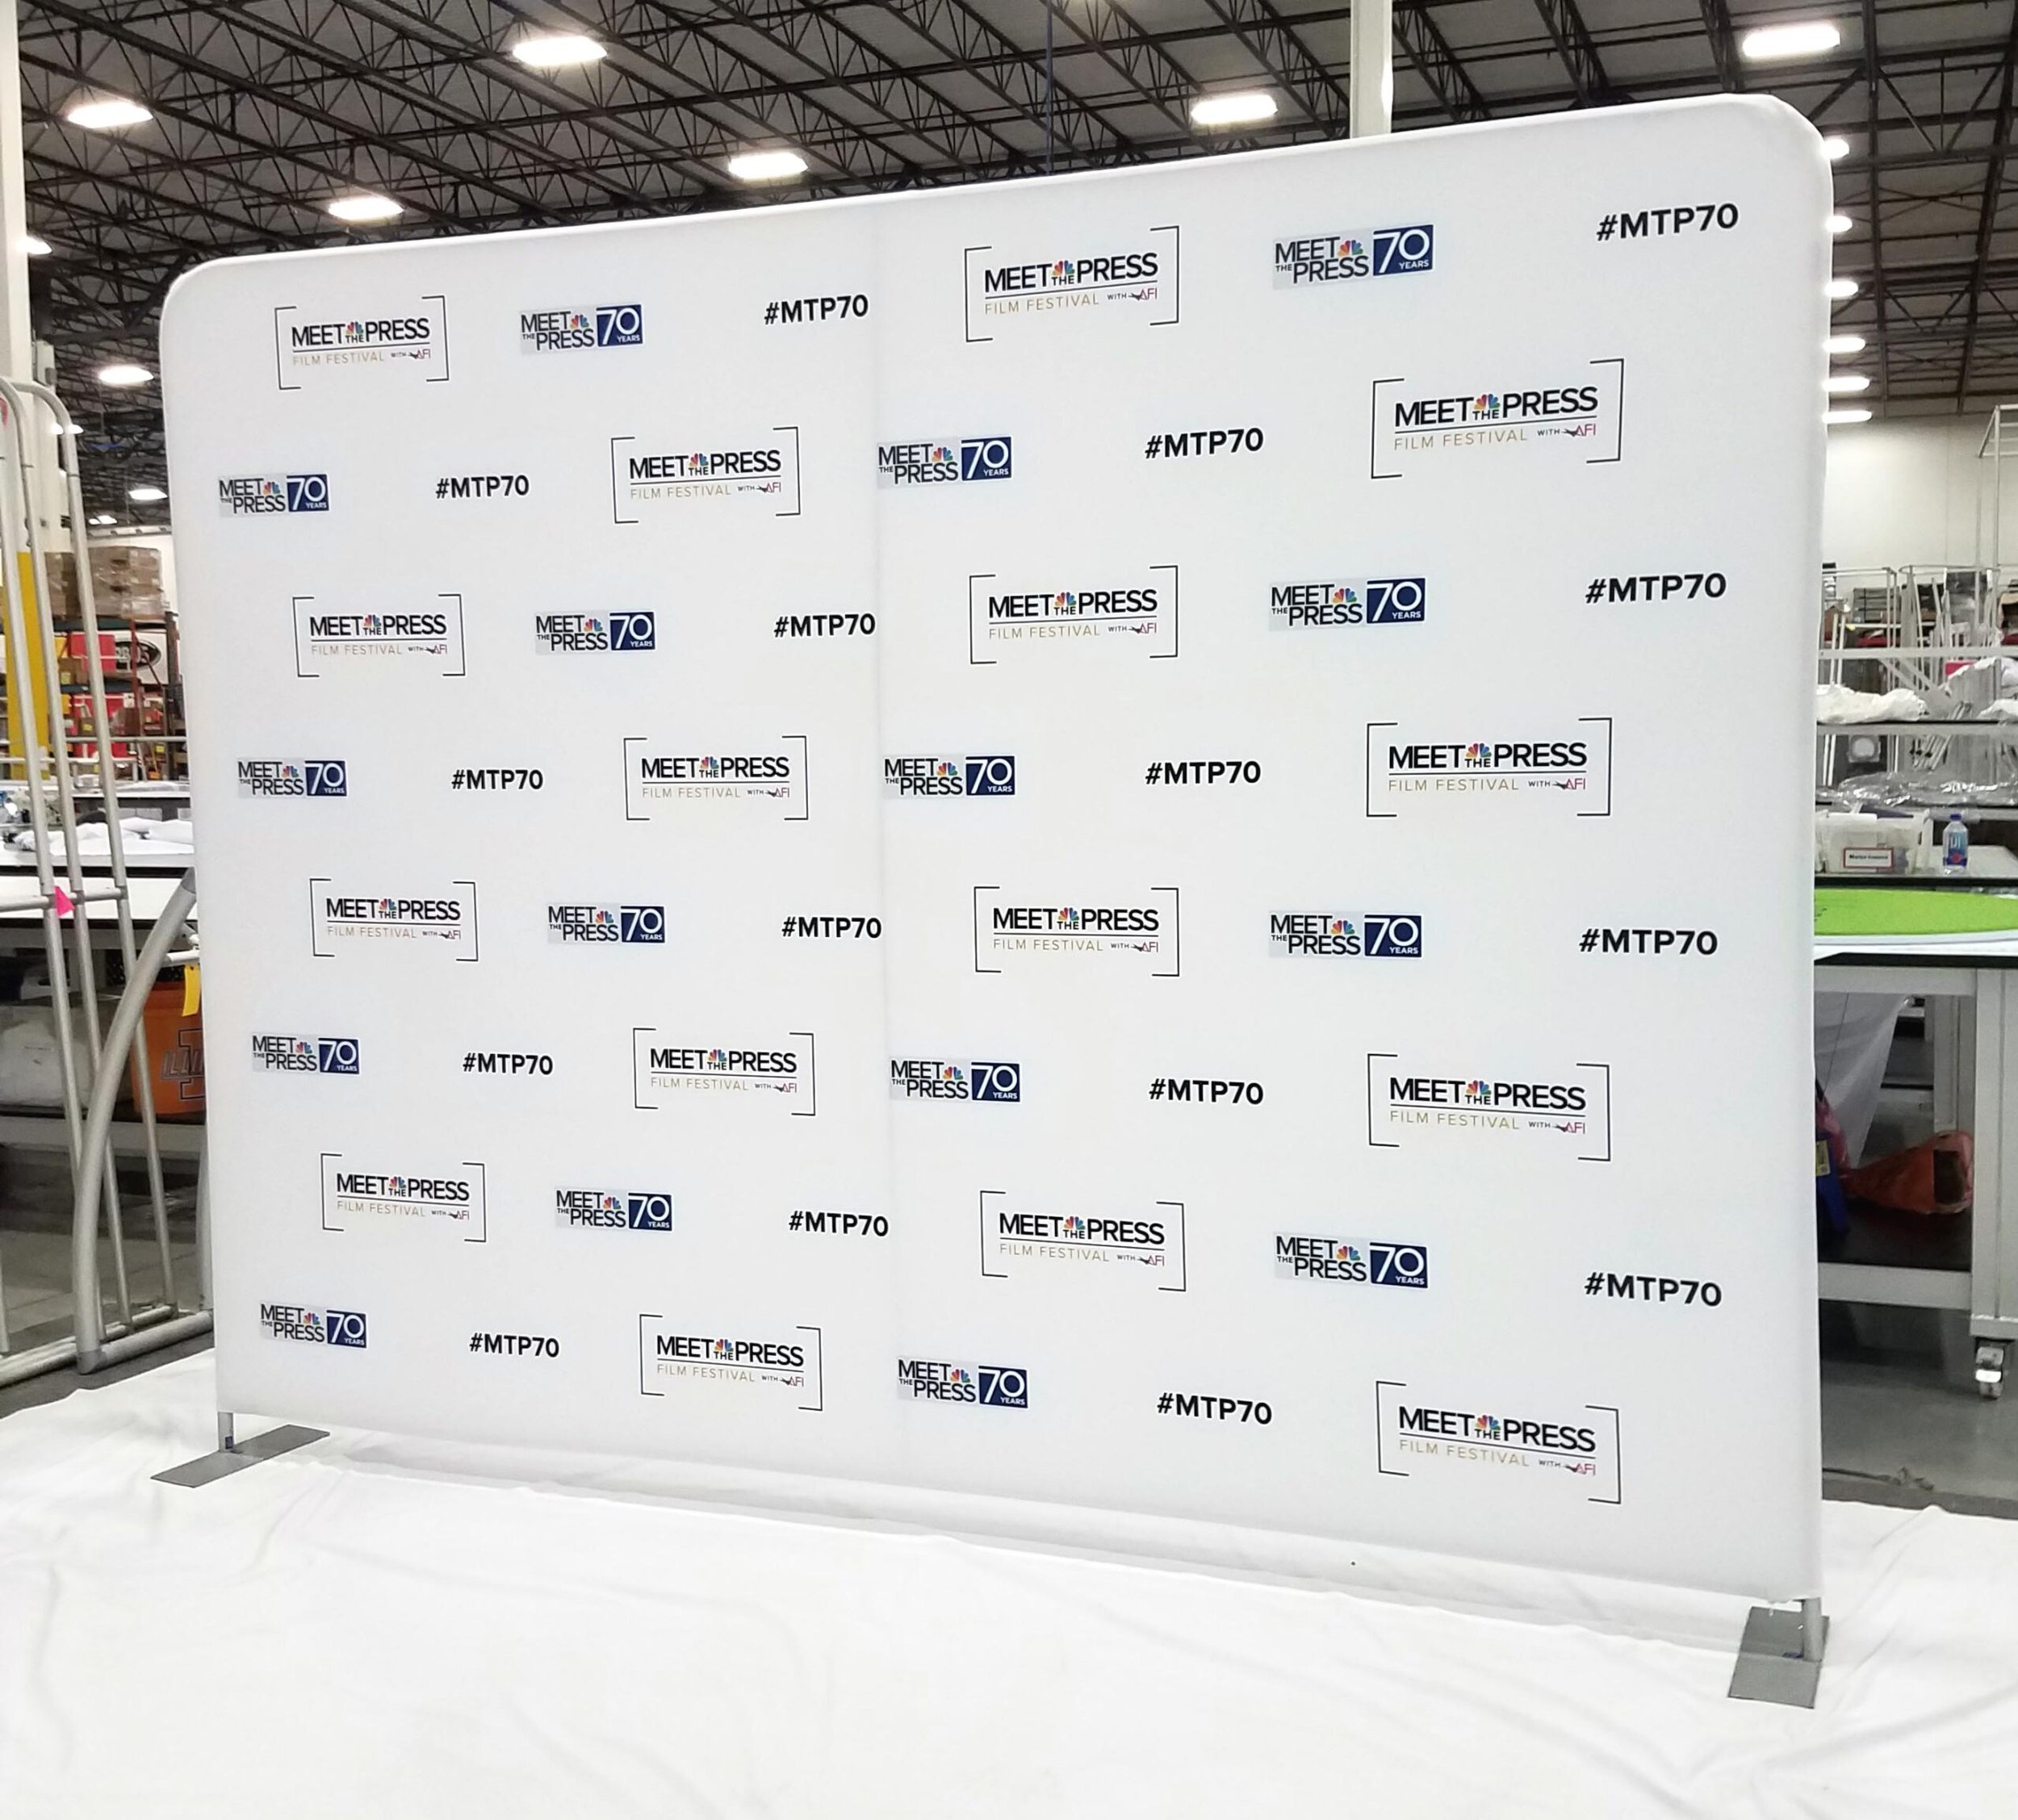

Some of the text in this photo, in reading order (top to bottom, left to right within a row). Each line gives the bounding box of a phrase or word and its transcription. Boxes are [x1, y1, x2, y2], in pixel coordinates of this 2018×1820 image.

[1597, 203, 1738, 241] #MTP70
[1275, 236, 1340, 263] MEET
[1374, 229, 1430, 273] 70
[985, 253, 1158, 292] MEET THE PRESS
[1276, 255, 1368, 283] THE PRESS
[1399, 259, 1429, 270] YEARS
[764, 295, 868, 324] #MTP70
[986, 294, 1099, 315] FILM FESTIVAL
[291, 318, 429, 346] MEET PRESS
[521, 311, 570, 332] MEET
[596, 308, 639, 345] 70
[536, 328, 594, 350] PRESS
[617, 334, 640, 342] YEARS
[326, 352, 384, 364] FESTIVAL
[1396, 387, 1597, 427] MEET THE PRESS
[1145, 428, 1263, 458] #MTP70
[1395, 424, 1596, 450] FILM FESTIVAL WITH AFI
[630, 450, 781, 479] MEET THE PRESS
[879, 443, 932, 465] MEET
[961, 440, 1008, 479] 70
[894, 462, 958, 483] PRESS
[983, 468, 1008, 476] YEARS
[219, 478, 263, 496] MEET
[287, 477, 325, 510] 70
[436, 475, 529, 498] #MTP70
[631, 485, 730, 499] FILM FESTIVAL
[233, 495, 286, 513] PRESS
[1272, 584, 1334, 606] MEET
[1585, 573, 1726, 603] #MTP70
[989, 589, 1157, 618] MEET THE PRESS
[1367, 582, 1421, 621] 70
[310, 614, 446, 636] MEET PRESS
[536, 615, 584, 633] MEET
[774, 613, 875, 637] #MTP70
[1289, 604, 1363, 625] PRESS
[1392, 611, 1421, 619] YEARS
[551, 633, 608, 651] PRESS
[609, 614, 651, 648] 70
[990, 625, 1099, 639] FILM FESTIVAL
[345, 645, 401, 655] FESTIVAL
[1389, 743, 1586, 768] MEET THE PRESS
[238, 761, 282, 778] MEET
[642, 757, 789, 778] MEET PRESS
[885, 758, 938, 776] MEET
[965, 759, 1011, 793] 70
[1145, 761, 1260, 784] #MTP70
[252, 778, 304, 795] PRESS
[305, 763, 343, 794] 70
[452, 770, 542, 789] #MTP70
[900, 776, 962, 795] PRESS
[1389, 780, 1426, 791] FILM
[1437, 779, 1518, 790] FESTIVAL
[1565, 779, 1585, 789] AFI
[643, 788, 739, 797] FILM FESTIVAL
[326, 898, 460, 920] MEET PRESS
[549, 906, 596, 923] MEET
[994, 908, 1057, 929] MEET
[1082, 909, 1158, 931] PRESS
[360, 927, 416, 938] FESTIVAL
[563, 923, 618, 941] PRESS
[621, 909, 662, 940] 70
[782, 917, 881, 938] #MTP70
[1271, 914, 1332, 935] MEET
[994, 939, 1103, 951] FILM FESTIVAL
[1288, 935, 1360, 955] PRESS
[1365, 918, 1418, 954] 70
[1580, 929, 1717, 955] #MTP70
[253, 1036, 295, 1053] MEET
[318, 1040, 356, 1071] 70
[266, 1052, 316, 1071] PRESS
[463, 1053, 552, 1074] #MTP70
[651, 1048, 797, 1073] MEET PRESS
[891, 1060, 944, 1079] MEET
[686, 1079, 747, 1090] FESTIVAL
[906, 1079, 969, 1099] PRESS
[971, 1065, 1017, 1098] 70
[1149, 1078, 1263, 1104] #MTP70
[1390, 1077, 1585, 1111] MEET THE PRESS
[1391, 1111, 1585, 1133] FILM FESTIVAL AFI
[337, 1174, 469, 1201] MEET PRESS
[370, 1203, 425, 1216] FESTIVAL
[556, 1190, 604, 1209] MEET
[571, 1208, 626, 1228] PRESS
[628, 1195, 669, 1228] 70
[789, 1211, 888, 1236] #MTP70
[999, 1213, 1164, 1245] MEET THE PRESS
[1000, 1244, 1108, 1261] FILM FESTIVAL
[1276, 1236, 1338, 1259] MEET
[1295, 1257, 1367, 1282] PRESS
[1370, 1245, 1424, 1282] 70
[1396, 1276, 1424, 1285] YEARS
[1585, 1272, 1721, 1306] #MTP70
[261, 1303, 304, 1324] MEET
[274, 1321, 324, 1342] PRESS
[326, 1312, 363, 1343] 70
[470, 1333, 559, 1358] #MTP70
[657, 1335, 803, 1366] MEET PRESS
[693, 1367, 754, 1382] FESTIVAL
[898, 1359, 951, 1381] MEET
[914, 1379, 976, 1403] PRESS
[978, 1368, 1024, 1403] 70
[1000, 1397, 1024, 1405] YEARS
[1158, 1393, 1271, 1425] #MTP70
[1399, 1406, 1595, 1453] MEET THE PRESS
[1400, 1440, 1595, 1475] FILM FESTIVAL WITH AFI
